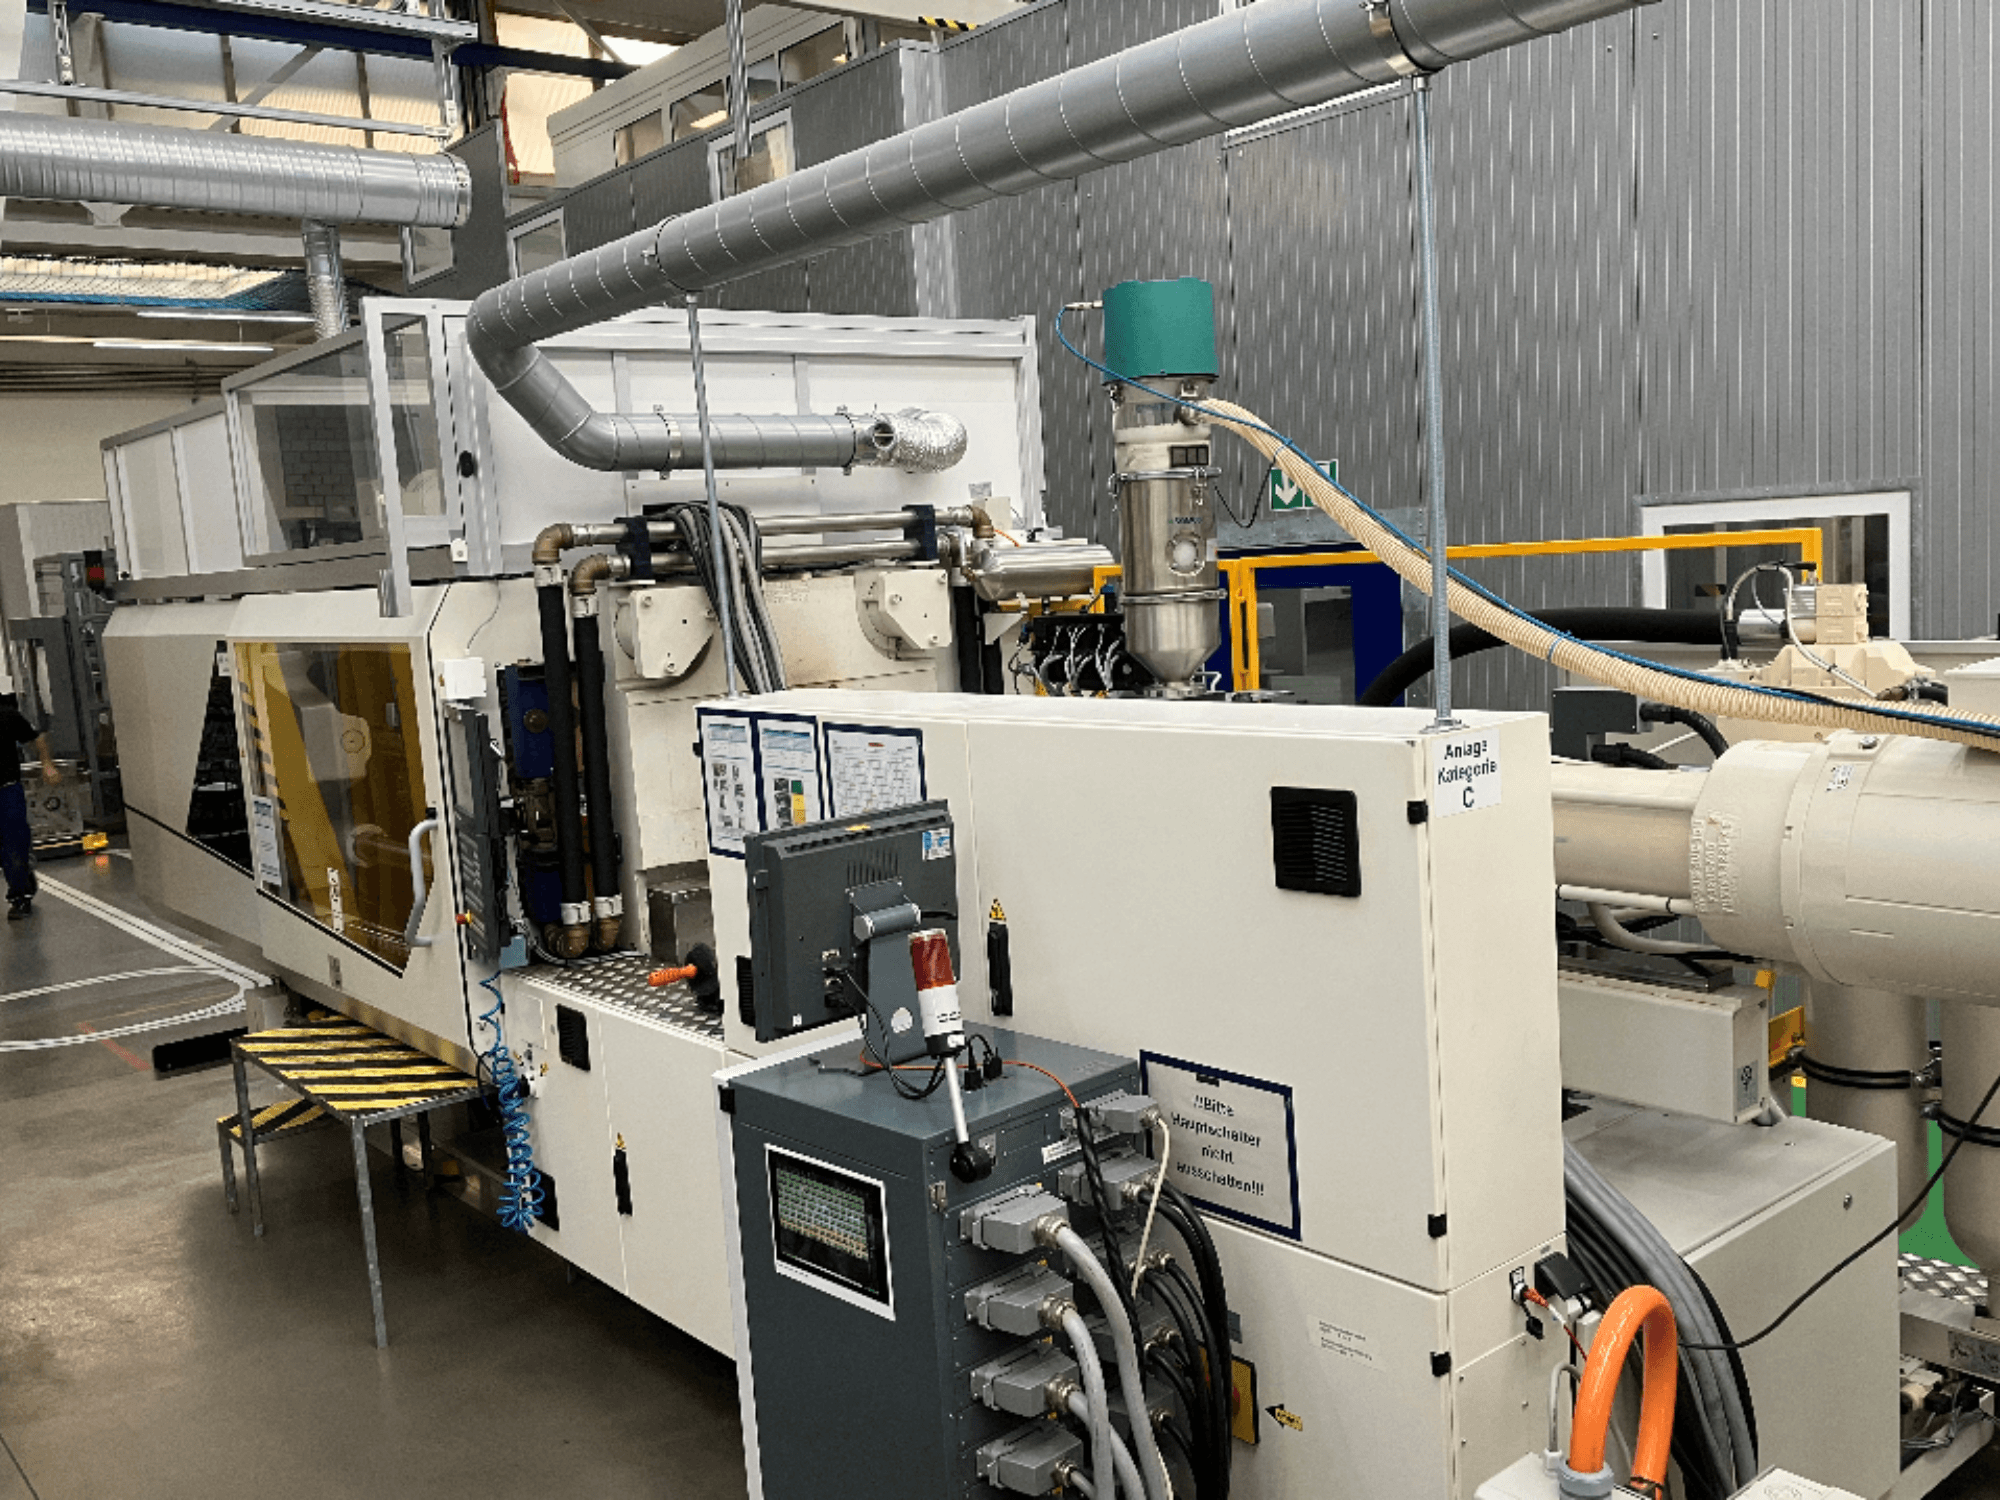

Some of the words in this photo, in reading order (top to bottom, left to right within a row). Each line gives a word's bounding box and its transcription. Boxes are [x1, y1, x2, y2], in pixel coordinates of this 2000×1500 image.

[1438, 758, 1497, 785] Kategorie
[1463, 786, 1474, 808] C
[1202, 1145, 1234, 1164] nicht
